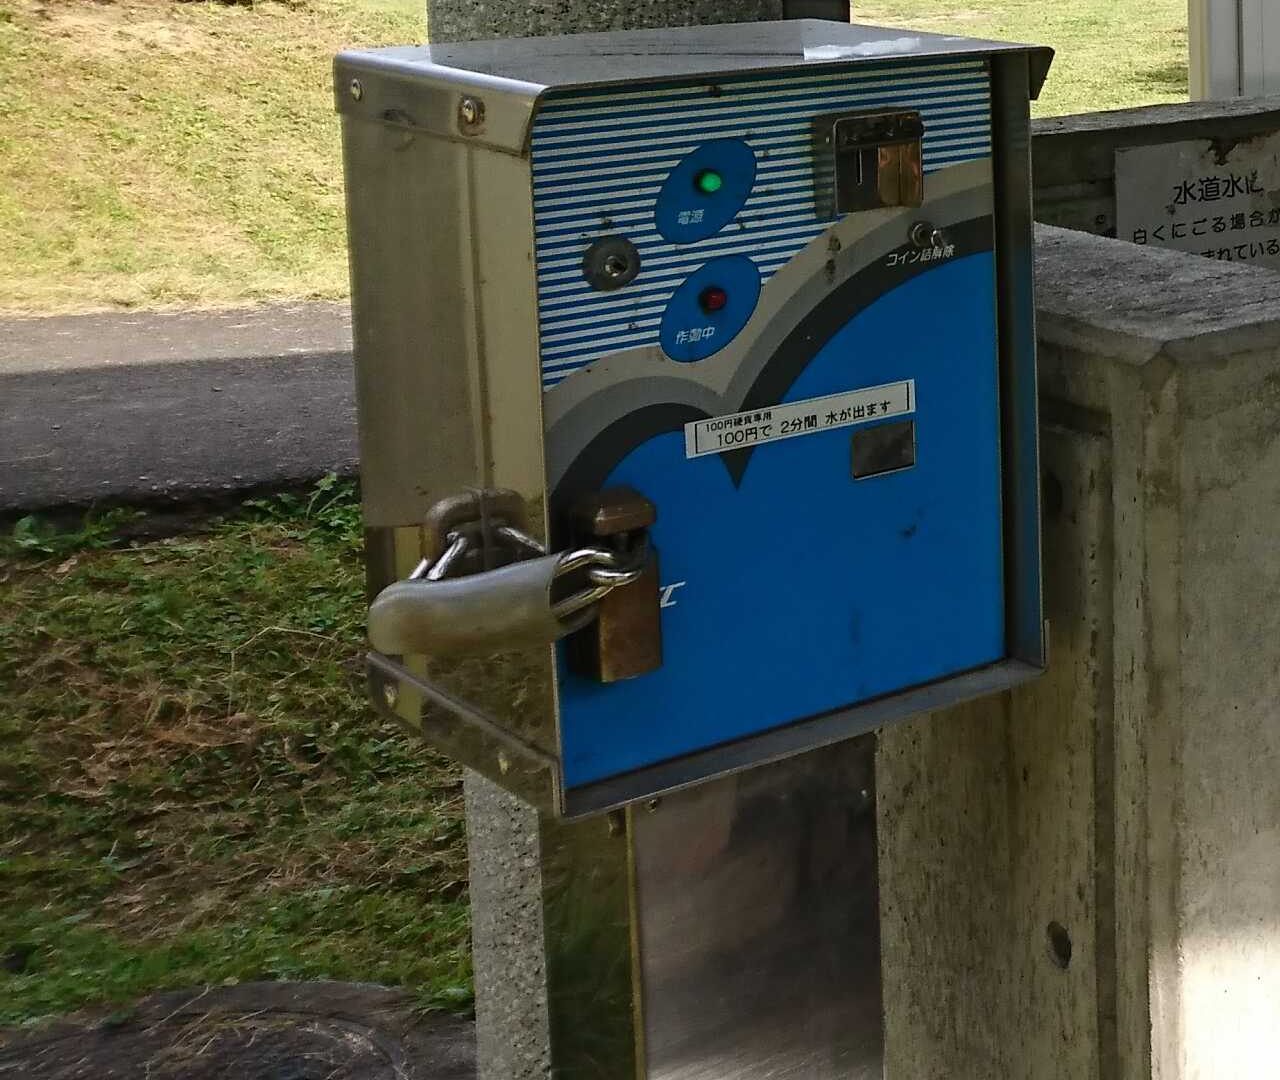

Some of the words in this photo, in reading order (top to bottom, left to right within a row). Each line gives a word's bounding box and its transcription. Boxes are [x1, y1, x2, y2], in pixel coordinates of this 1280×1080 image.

[676, 208, 705, 225] 電源
[886, 243, 956, 268] コイン詰解除
[675, 325, 715, 346] 作動中
[705, 411, 773, 433] 100円硬貨専用
[717, 423, 773, 447] 100円で
[780, 414, 818, 434] 2分間
[825, 399, 892, 425] 水が出ます
